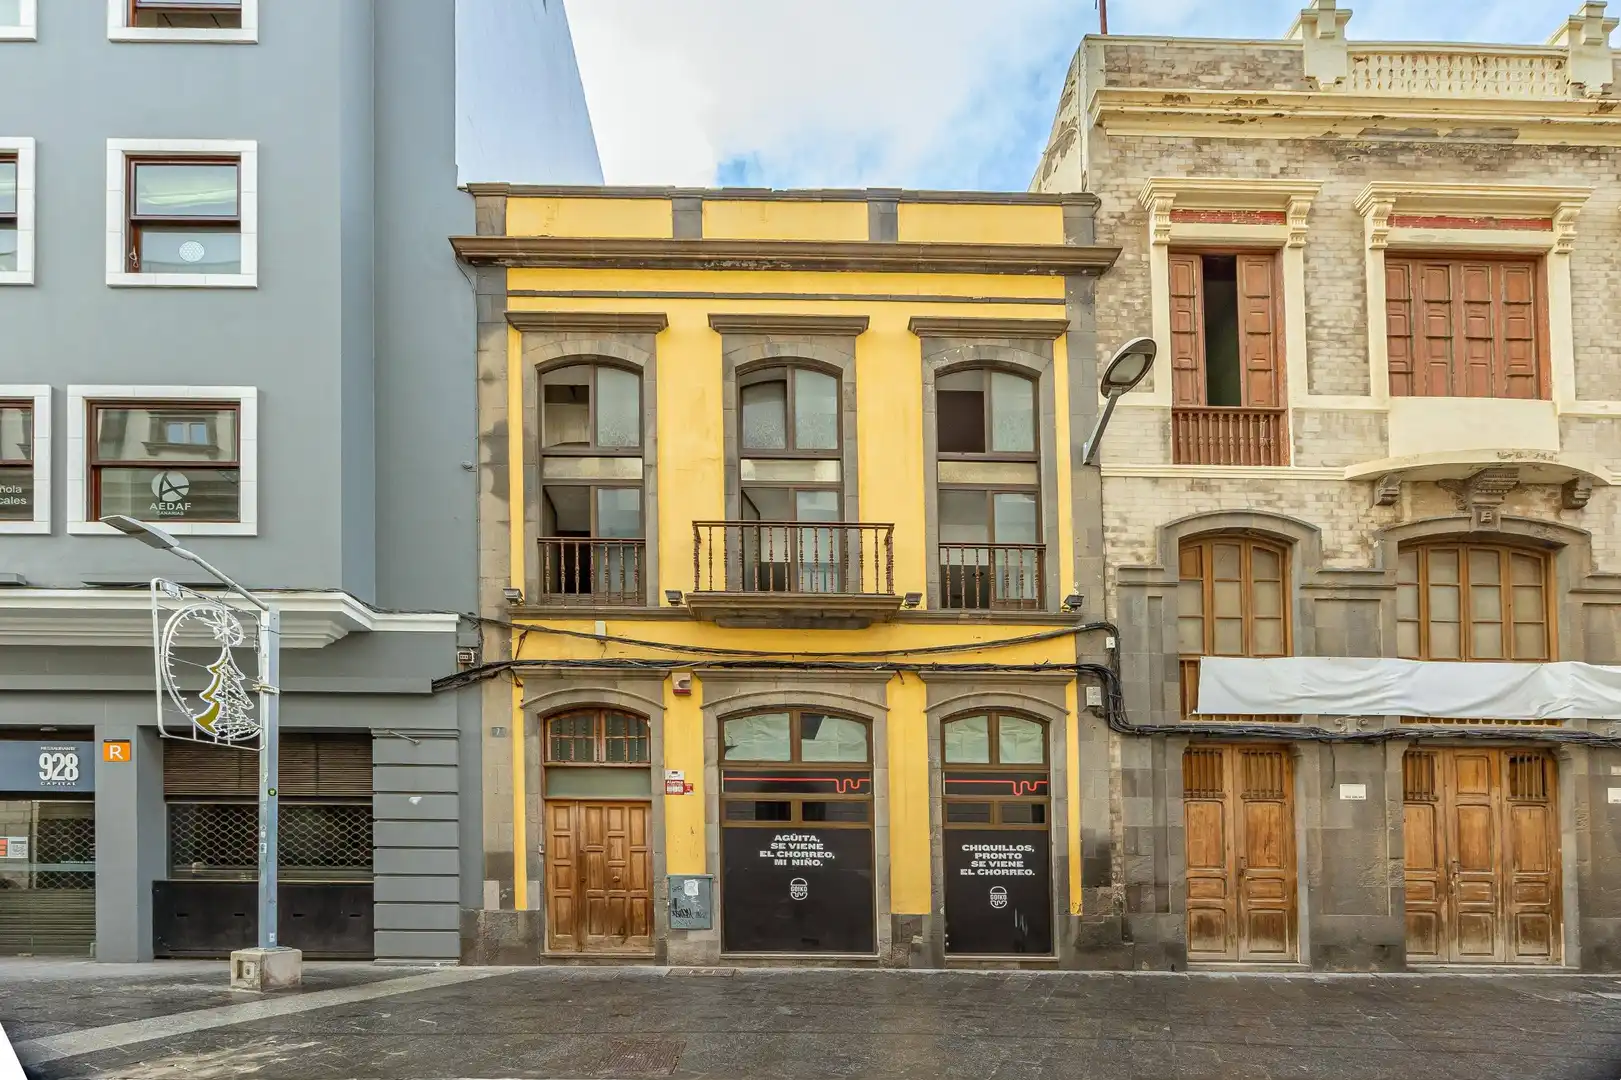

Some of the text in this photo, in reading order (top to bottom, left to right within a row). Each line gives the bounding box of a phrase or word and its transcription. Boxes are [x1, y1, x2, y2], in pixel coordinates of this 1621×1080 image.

[149, 502, 191, 510] AEDAF
[109, 744, 124, 760] R
[38, 752, 79, 781] 928
[774, 833, 820, 843] AGÜITA,
[770, 842, 786, 850] SE
[961, 844, 1035, 852] CHIQUILLOS,
[759, 850, 835, 860] EL CHORREO,
[974, 852, 1023, 860] PRONTO
[792, 857, 823, 867] NIÑO.
[970, 860, 1024, 868] SE VIENE
[960, 868, 1035, 876] EL CHORREO.
